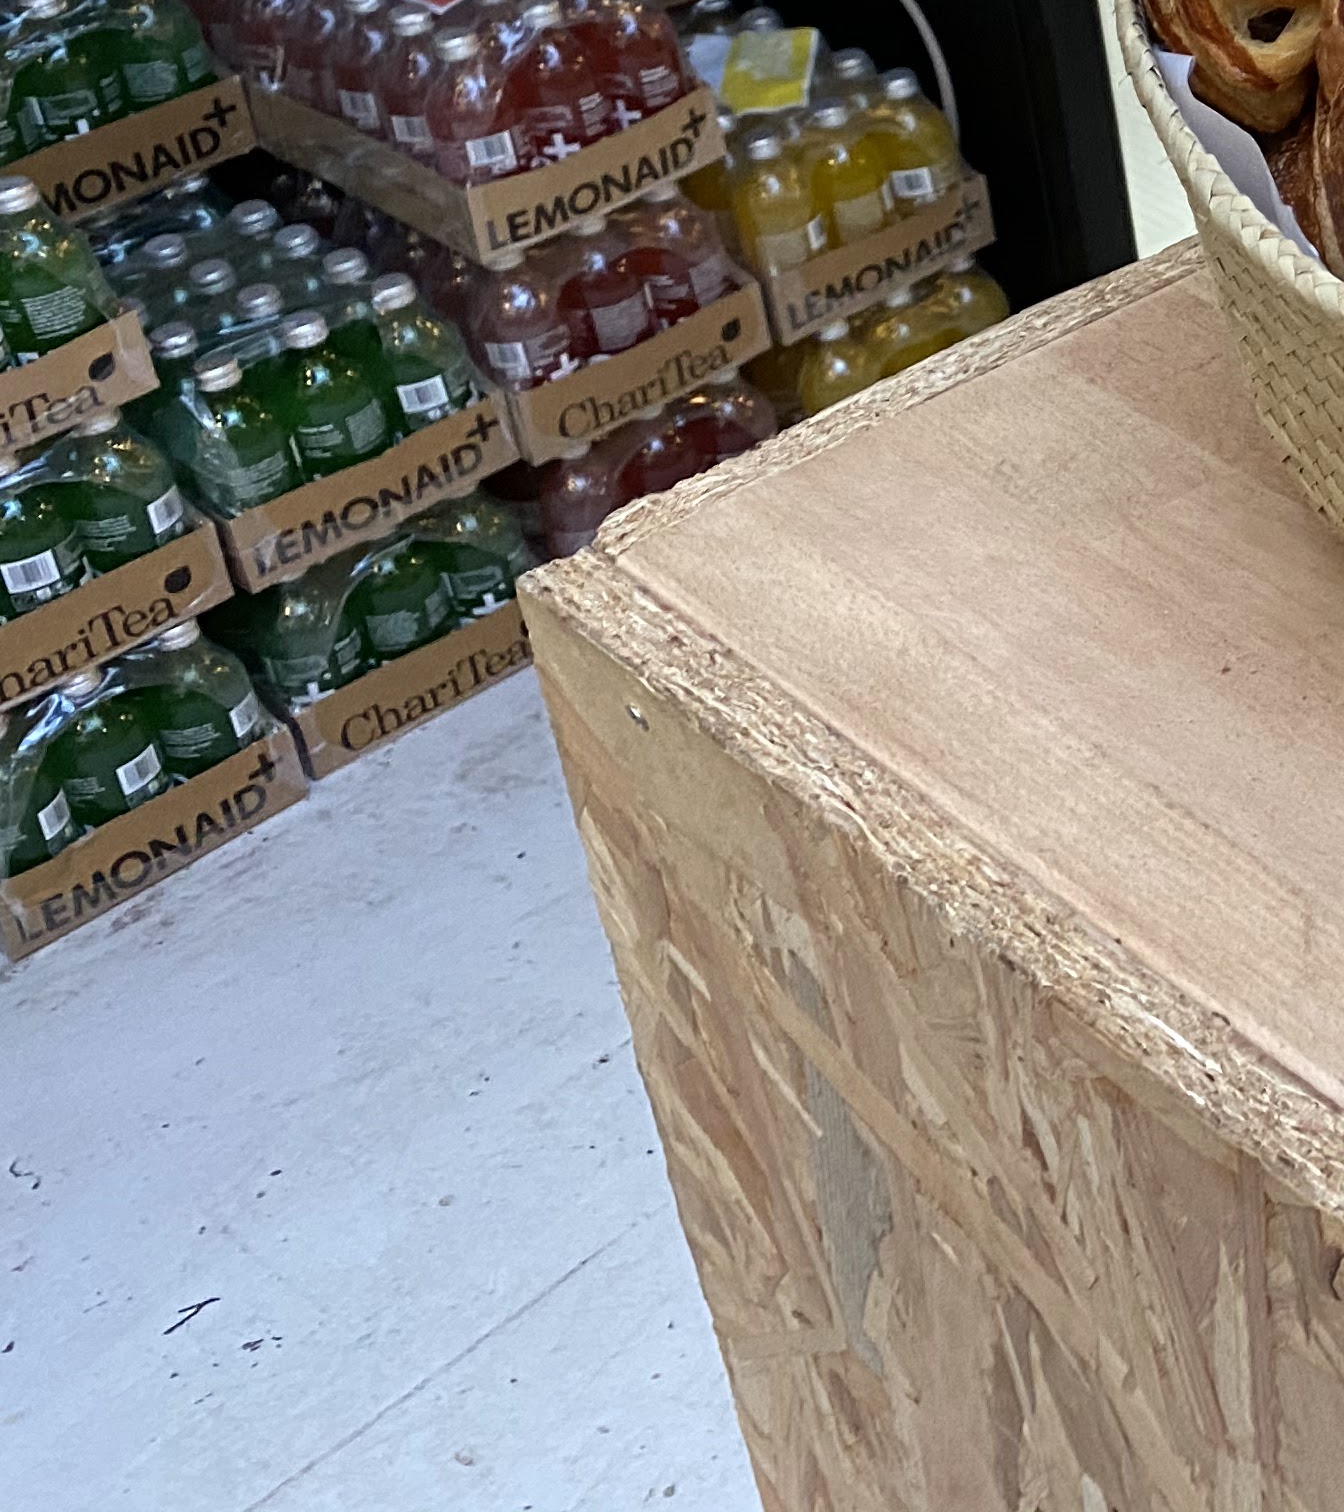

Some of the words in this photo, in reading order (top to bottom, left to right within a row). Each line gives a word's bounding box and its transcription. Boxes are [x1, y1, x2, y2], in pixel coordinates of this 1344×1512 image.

[40, 96, 237, 216] MONAID+
[557, 344, 734, 439] ChariTea
[340, 639, 534, 751] ChariTea
